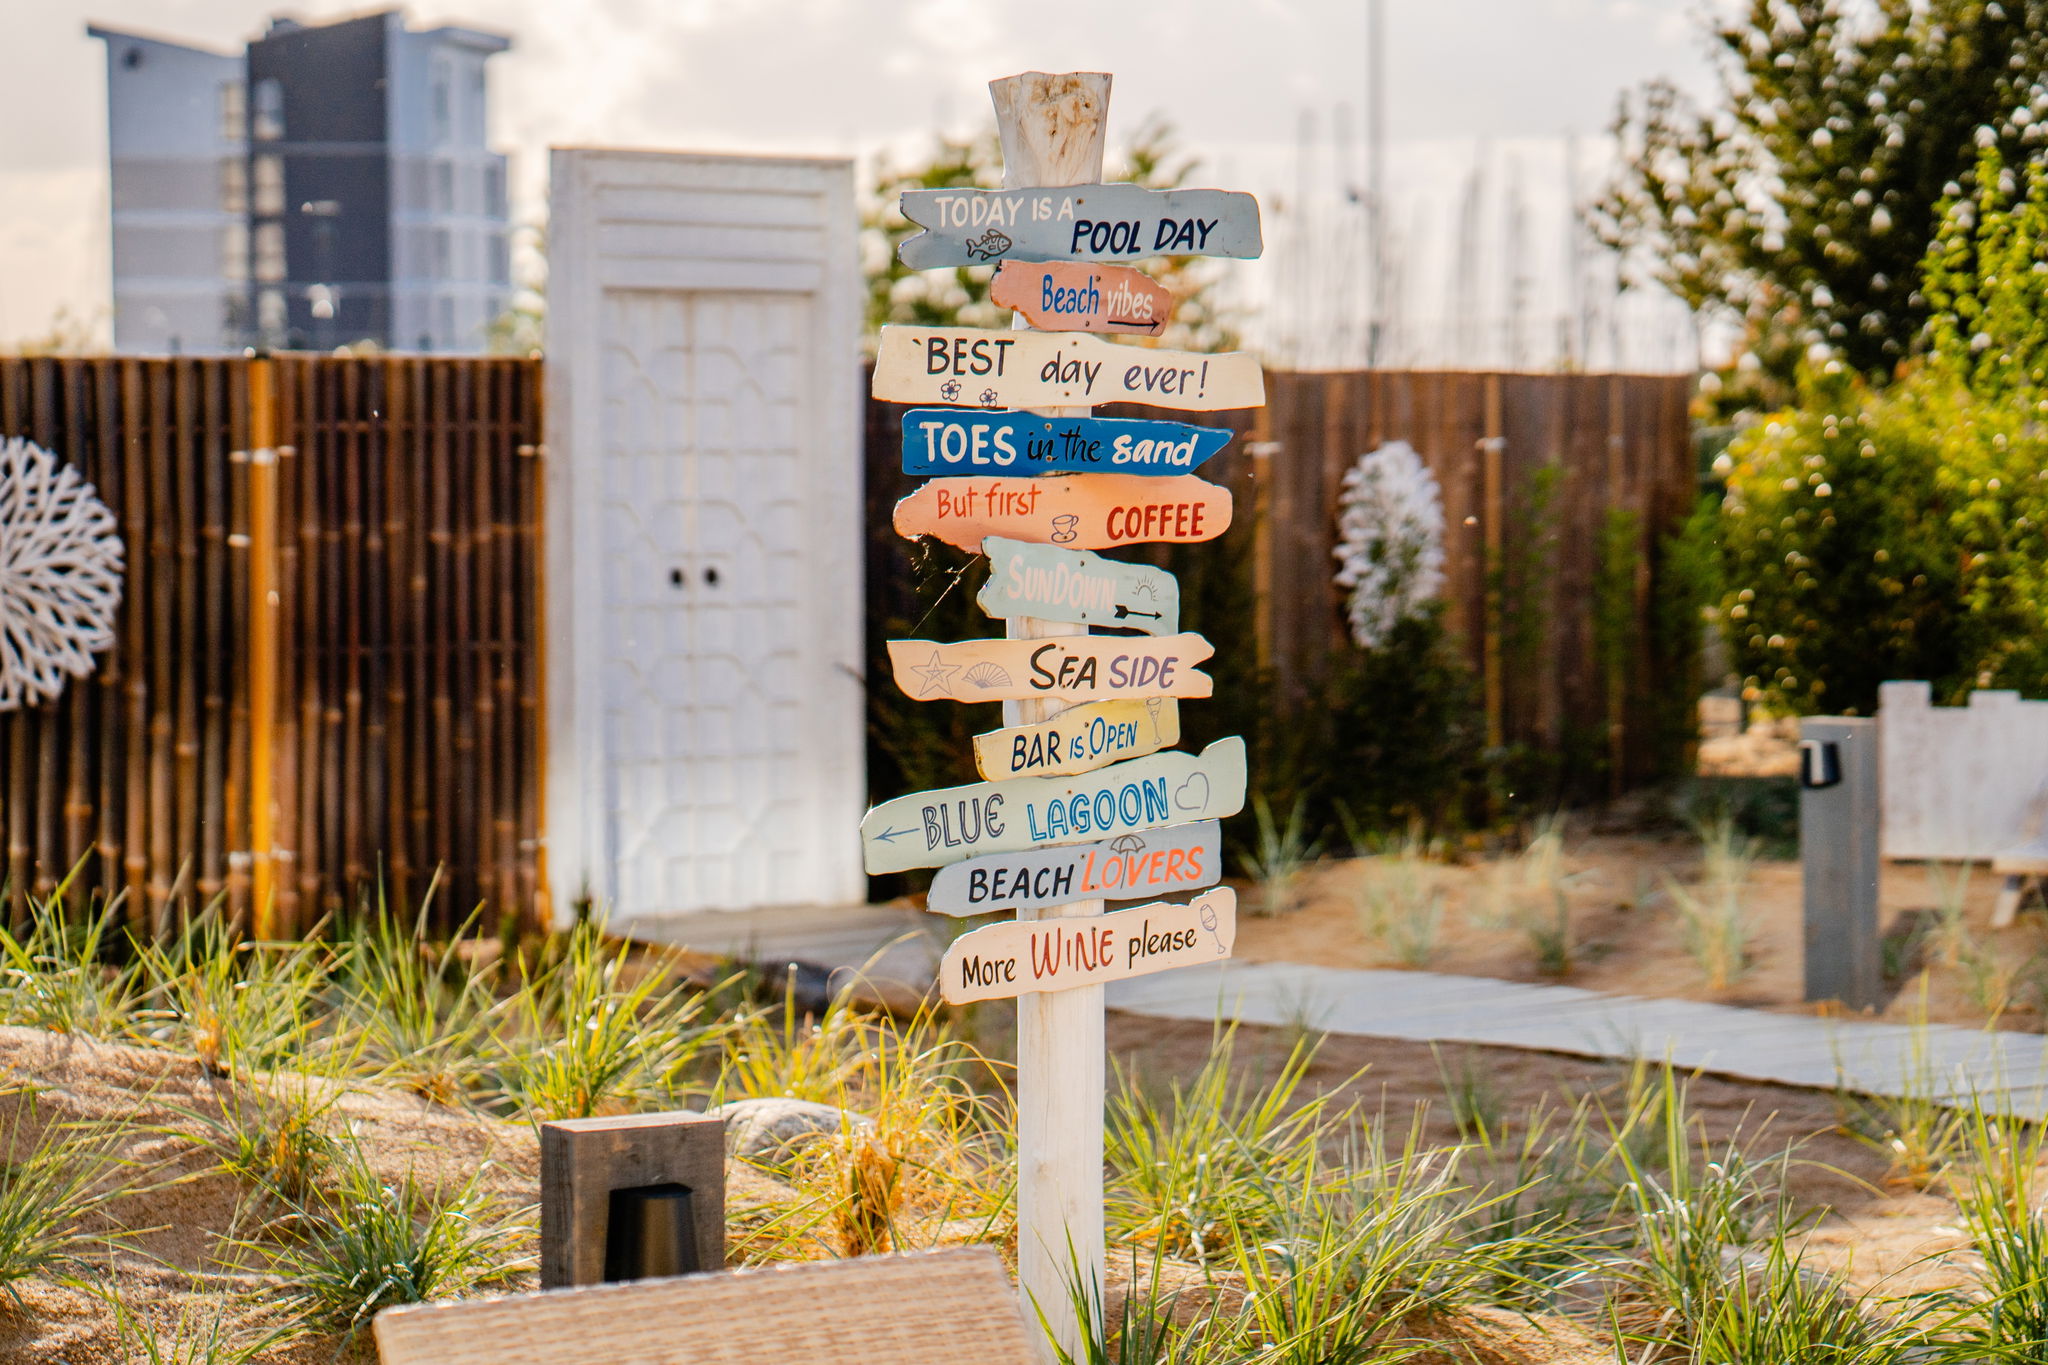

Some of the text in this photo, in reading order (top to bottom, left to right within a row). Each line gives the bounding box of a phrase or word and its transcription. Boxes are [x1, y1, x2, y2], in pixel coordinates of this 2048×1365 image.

[934, 196, 1075, 228] TODAY IS A
[1070, 218, 1218, 254] POOL DAY
[1041, 274, 1153, 319] Beach vibes
[926, 336, 1208, 399] BEST day ever!
[918, 421, 1199, 466] TOES in the sand
[936, 482, 1042, 519] But first
[1106, 502, 1206, 541] COFFEE
[1029, 643, 1180, 690] SEA SIDE
[1010, 730, 1062, 773] BAR
[921, 776, 1170, 852] BLUE LAGOON
[968, 845, 1205, 903] BEACH LOVERS
[961, 918, 1197, 989] More WINE please
